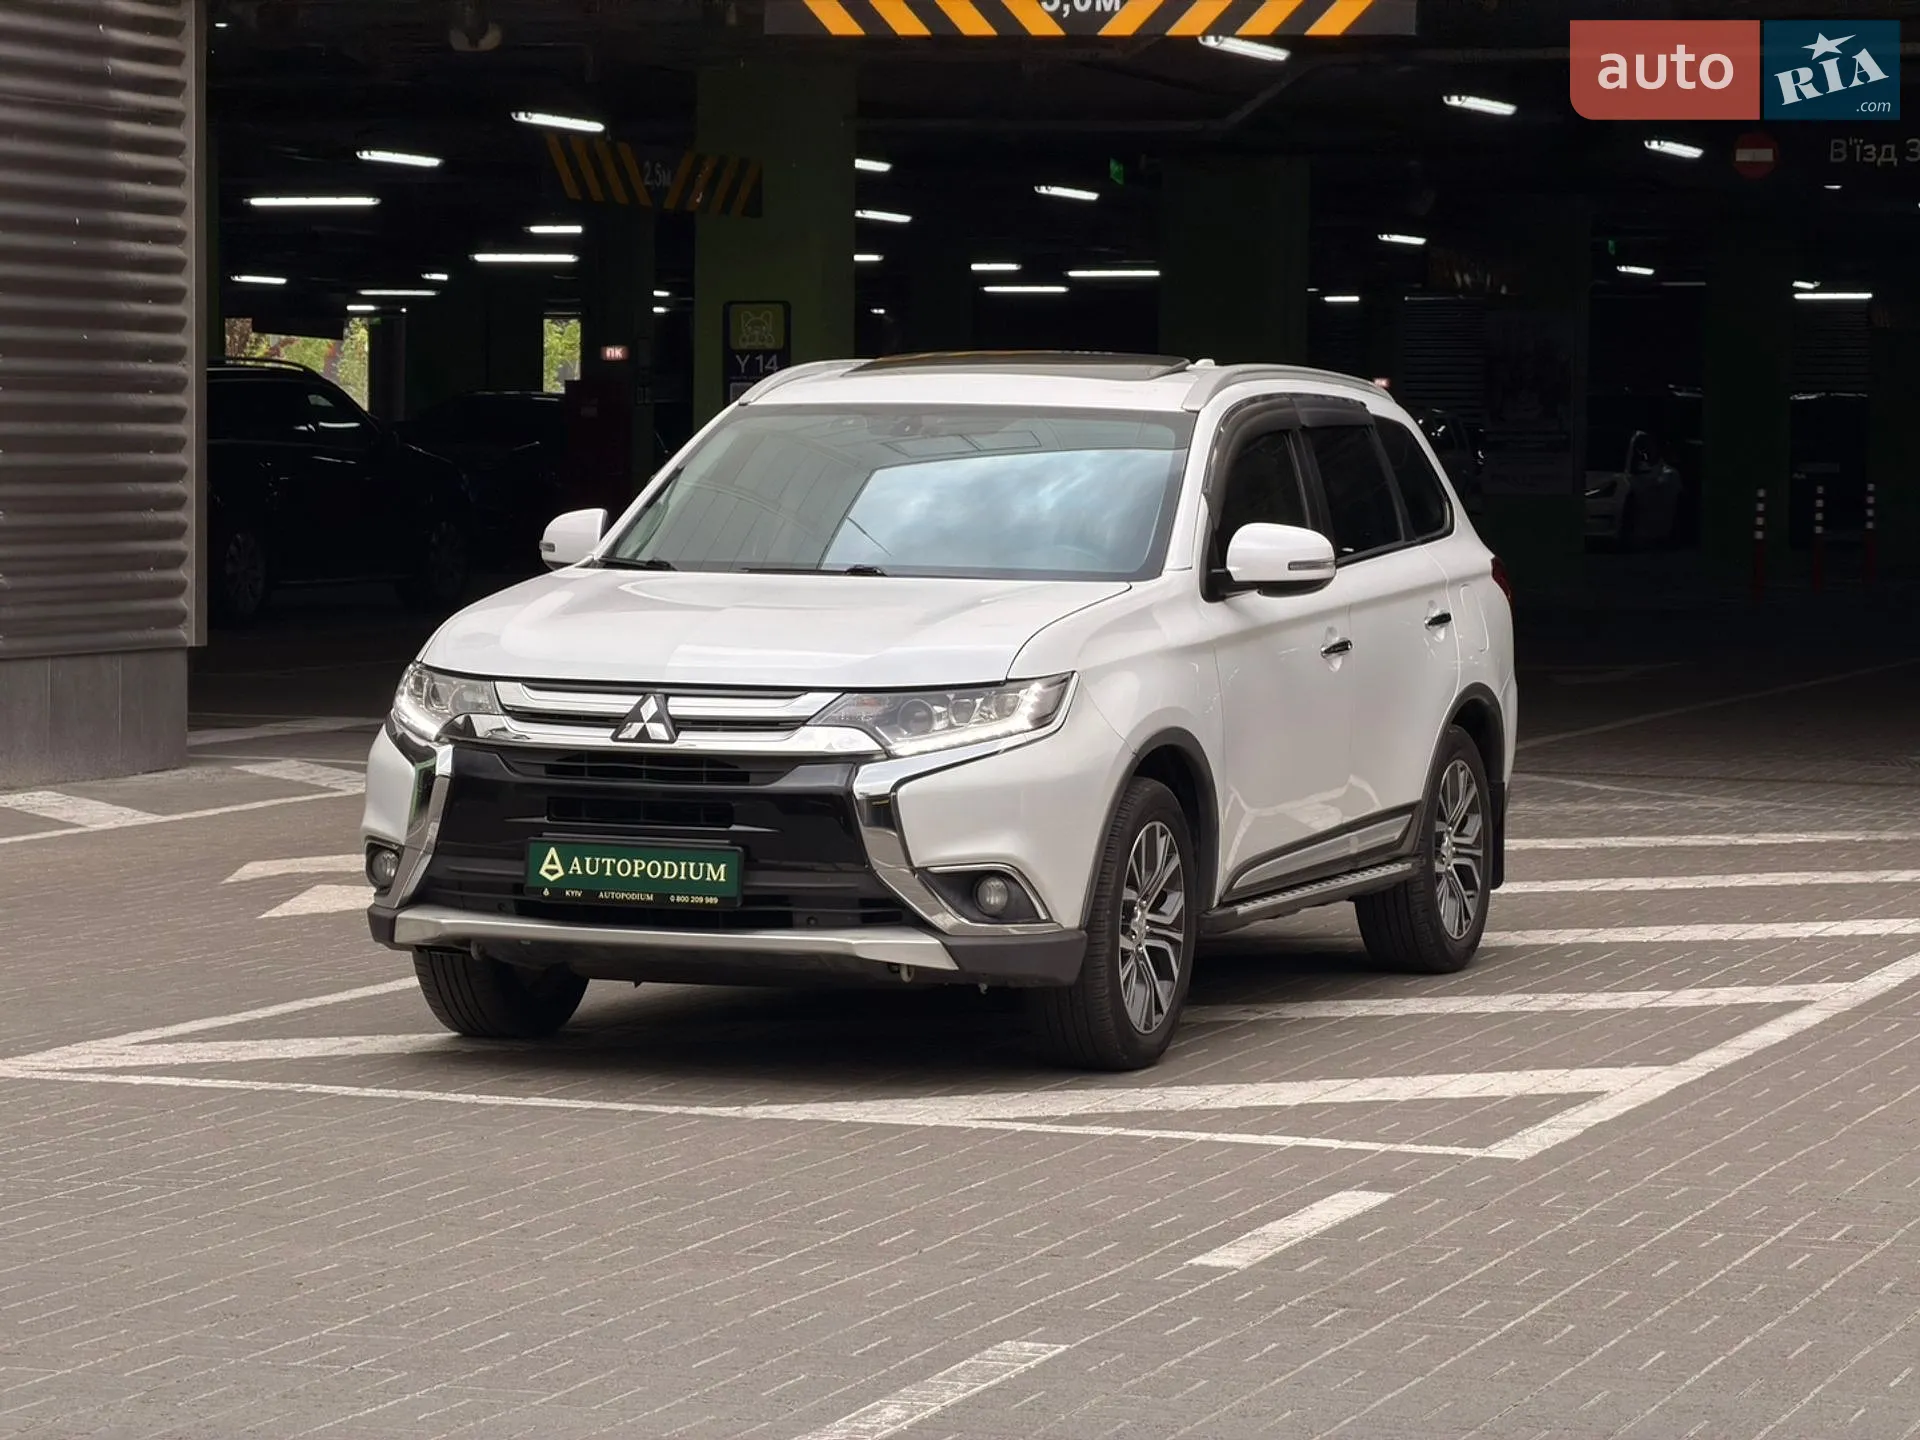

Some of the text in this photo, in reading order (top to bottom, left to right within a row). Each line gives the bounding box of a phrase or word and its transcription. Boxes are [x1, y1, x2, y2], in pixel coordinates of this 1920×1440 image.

[754, 354, 778, 374] 14
[568, 857, 726, 882] AUTOPODIUM
[565, 889, 583, 897] KYIV
[599, 891, 654, 901] AUTOPODIUM
